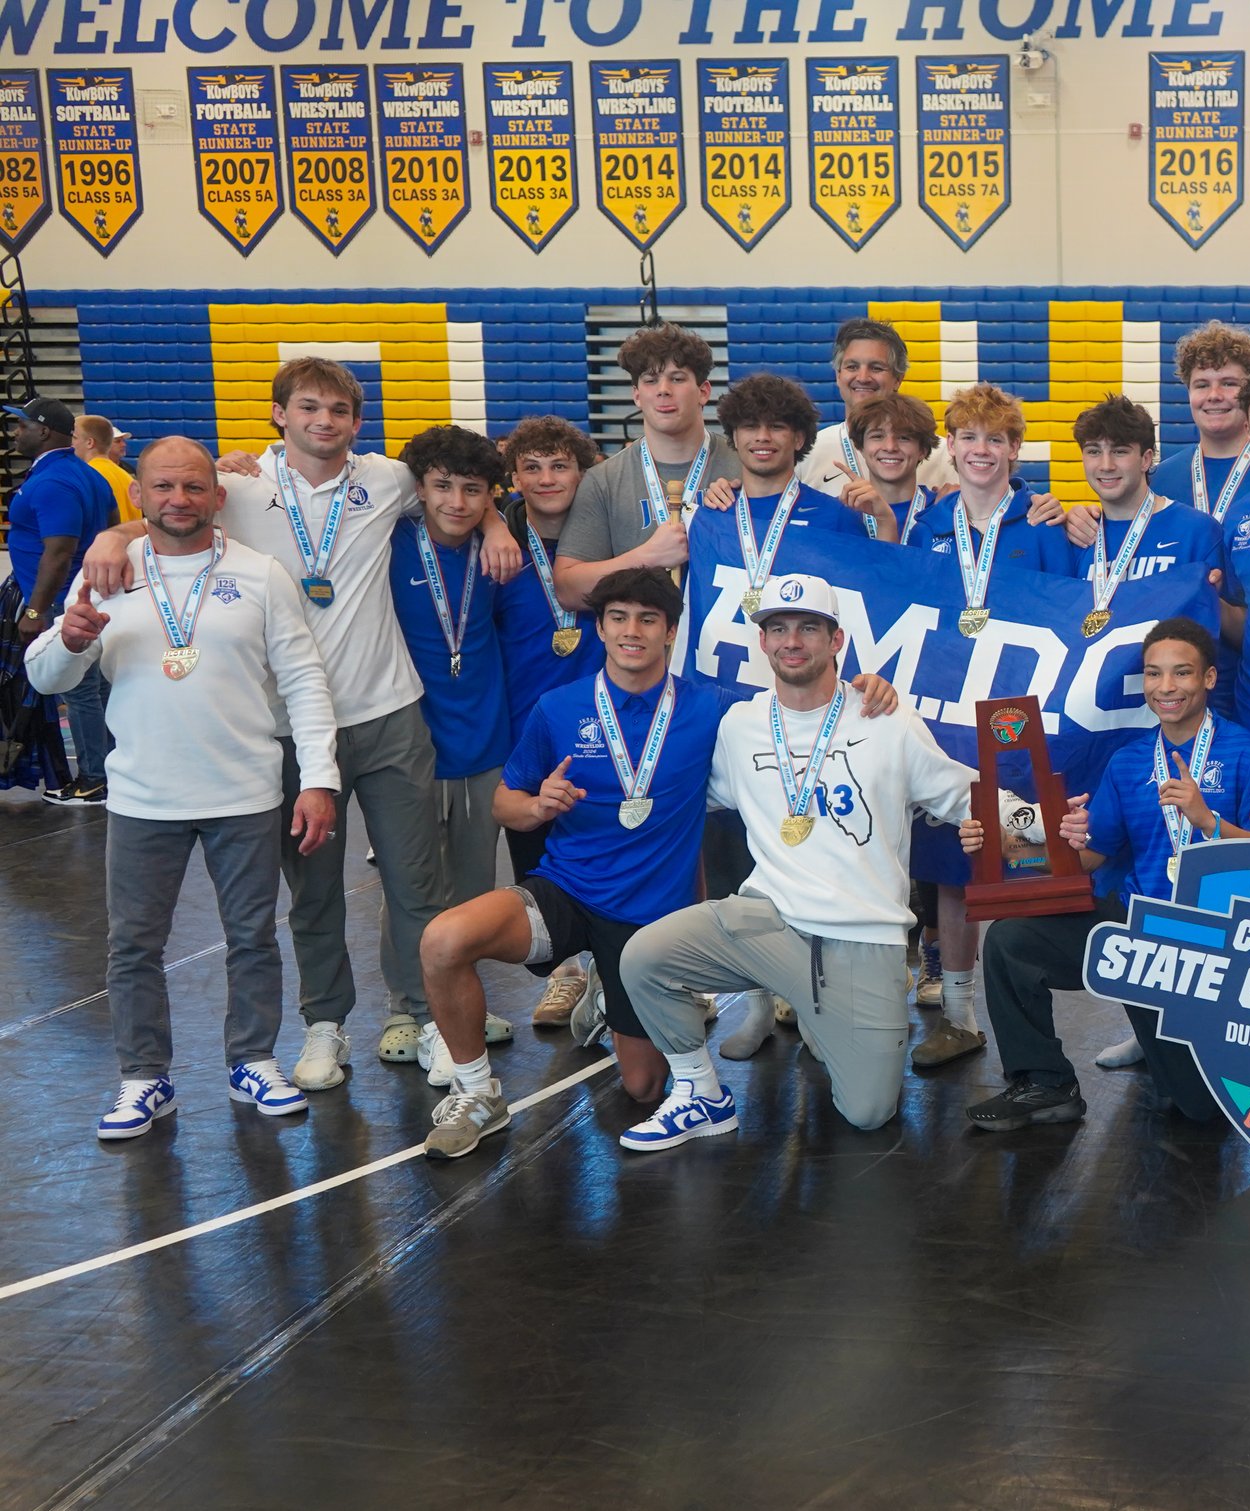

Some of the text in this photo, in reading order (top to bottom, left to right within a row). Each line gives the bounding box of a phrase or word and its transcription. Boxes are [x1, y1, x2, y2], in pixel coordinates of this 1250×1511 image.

[0, 0, 474, 55] WELCOME
[512, 0, 643, 48] TO
[503, 78, 557, 95] KOWBOYS
[609, 77, 664, 94] KOWBOYS
[935, 73, 992, 91] KOWBOYS
[1168, 71, 1227, 86] KOWBOYS
[65, 86, 119, 102] KOWBOYS
[206, 84, 260, 101] KOWBOYS
[1155, 91, 1176, 107] BOYS
[1178, 91, 1206, 106] TRACK
[1214, 91, 1238, 106] FIELD
[491, 99, 568, 116] WRESTLING
[598, 97, 676, 114] WRESTLING
[923, 93, 1003, 111] BASKETBALL
[57, 106, 130, 122] SOFTBALL
[196, 103, 271, 120] FOOTBALL
[1173, 112, 1220, 124] STATE
[213, 123, 257, 136] STATE
[508, 119, 552, 132] STATE
[615, 118, 660, 131] STATE
[940, 114, 986, 128] STATE
[73, 125, 117, 138] STATE
[493, 133, 570, 146] RUNNER-UP
[599, 132, 677, 145] RUNNER-UP
[924, 128, 1004, 142] RUNNER-UP
[1156, 126, 1238, 139] RUNNER-UP
[59, 138, 131, 150] RUNNER-UP
[199, 137, 273, 150] RUNNER-UP
[500, 155, 567, 182] 2013
[605, 153, 674, 180] 2014
[929, 150, 999, 178] 2015
[1160, 149, 1233, 175] 2016
[64, 160, 130, 186] 1996
[206, 158, 270, 185] 2007
[68, 189, 132, 204] CLASS 5A
[208, 188, 273, 204] CLASS 5A
[500, 185, 568, 200] CLASS 3A
[606, 184, 675, 199] CLASS 3A
[929, 181, 999, 197] CLASS 7A
[1160, 182, 1232, 194] CLASS 4A
[688, 447, 707, 492] WRESTLING
[1218, 470, 1241, 514] WRESTLING
[738, 497, 750, 537] WRESTLING
[290, 505, 311, 556] WRESTLING
[322, 501, 340, 553] WRESTLING
[767, 509, 787, 552] WRESTLING
[981, 524, 996, 572] WRESTLING
[1115, 532, 1138, 576] WRESTLING
[424, 551, 443, 600] WRESTLING
[599, 691, 618, 741] WRESTLING
[647, 711, 667, 762] WRESTLING
[1192, 728, 1210, 779] WRESTLING
[815, 785, 855, 817] 13
[1097, 934, 1231, 1002] STATE
